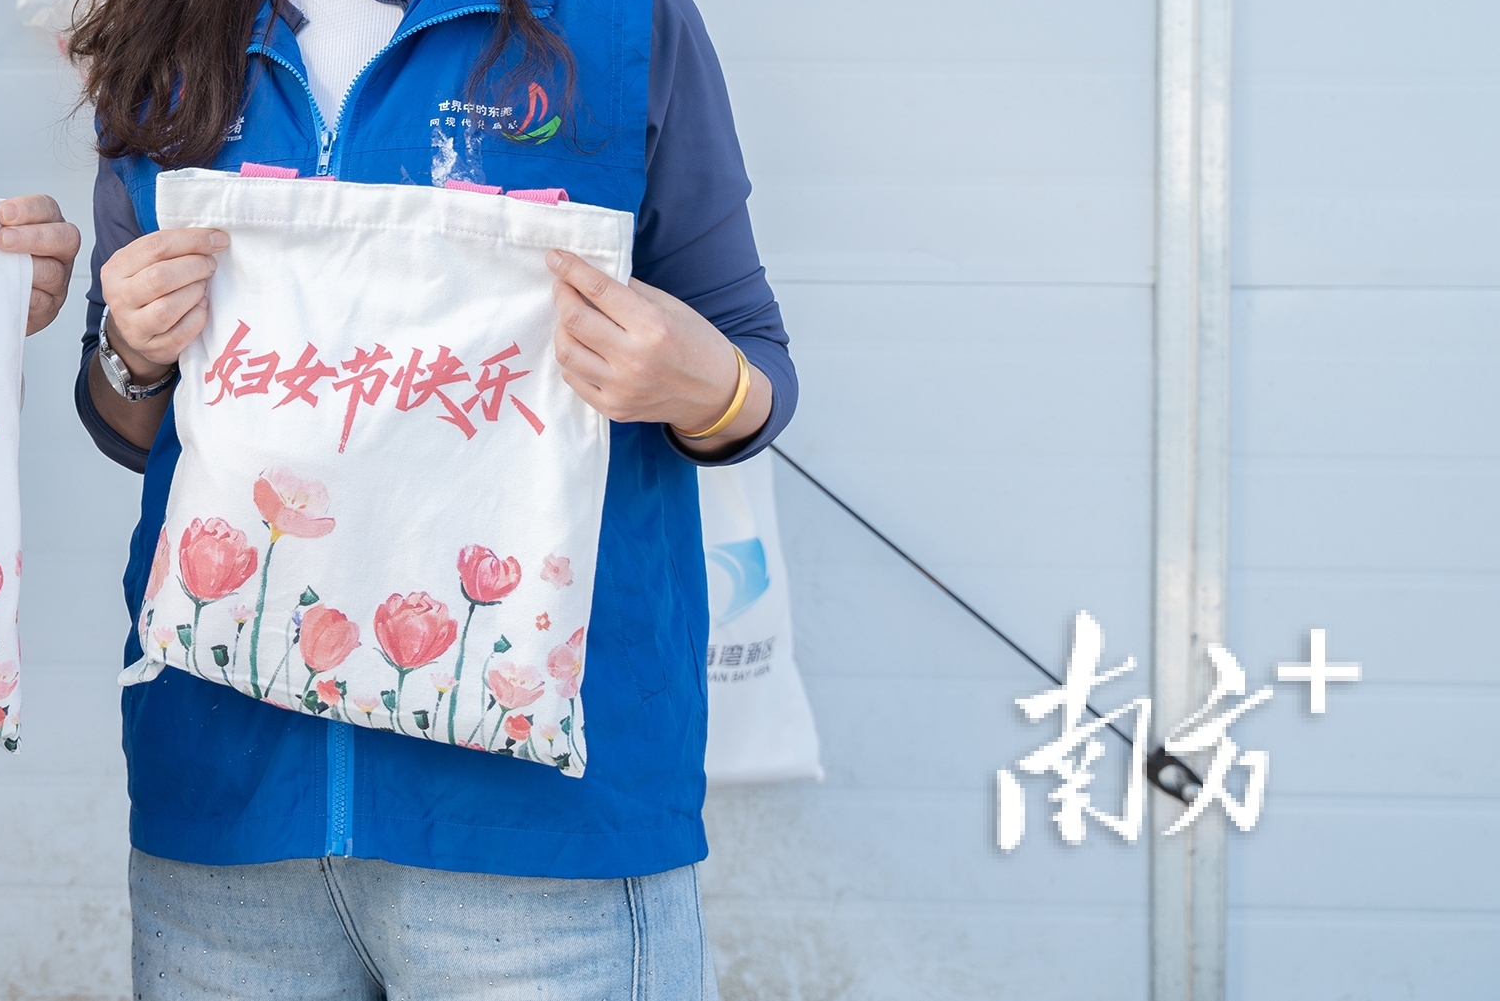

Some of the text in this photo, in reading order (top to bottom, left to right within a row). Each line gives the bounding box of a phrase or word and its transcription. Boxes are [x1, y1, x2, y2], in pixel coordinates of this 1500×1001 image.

[438, 100, 512, 118] 世界中的东莞
[204, 318, 545, 454] 妇女节快乐
